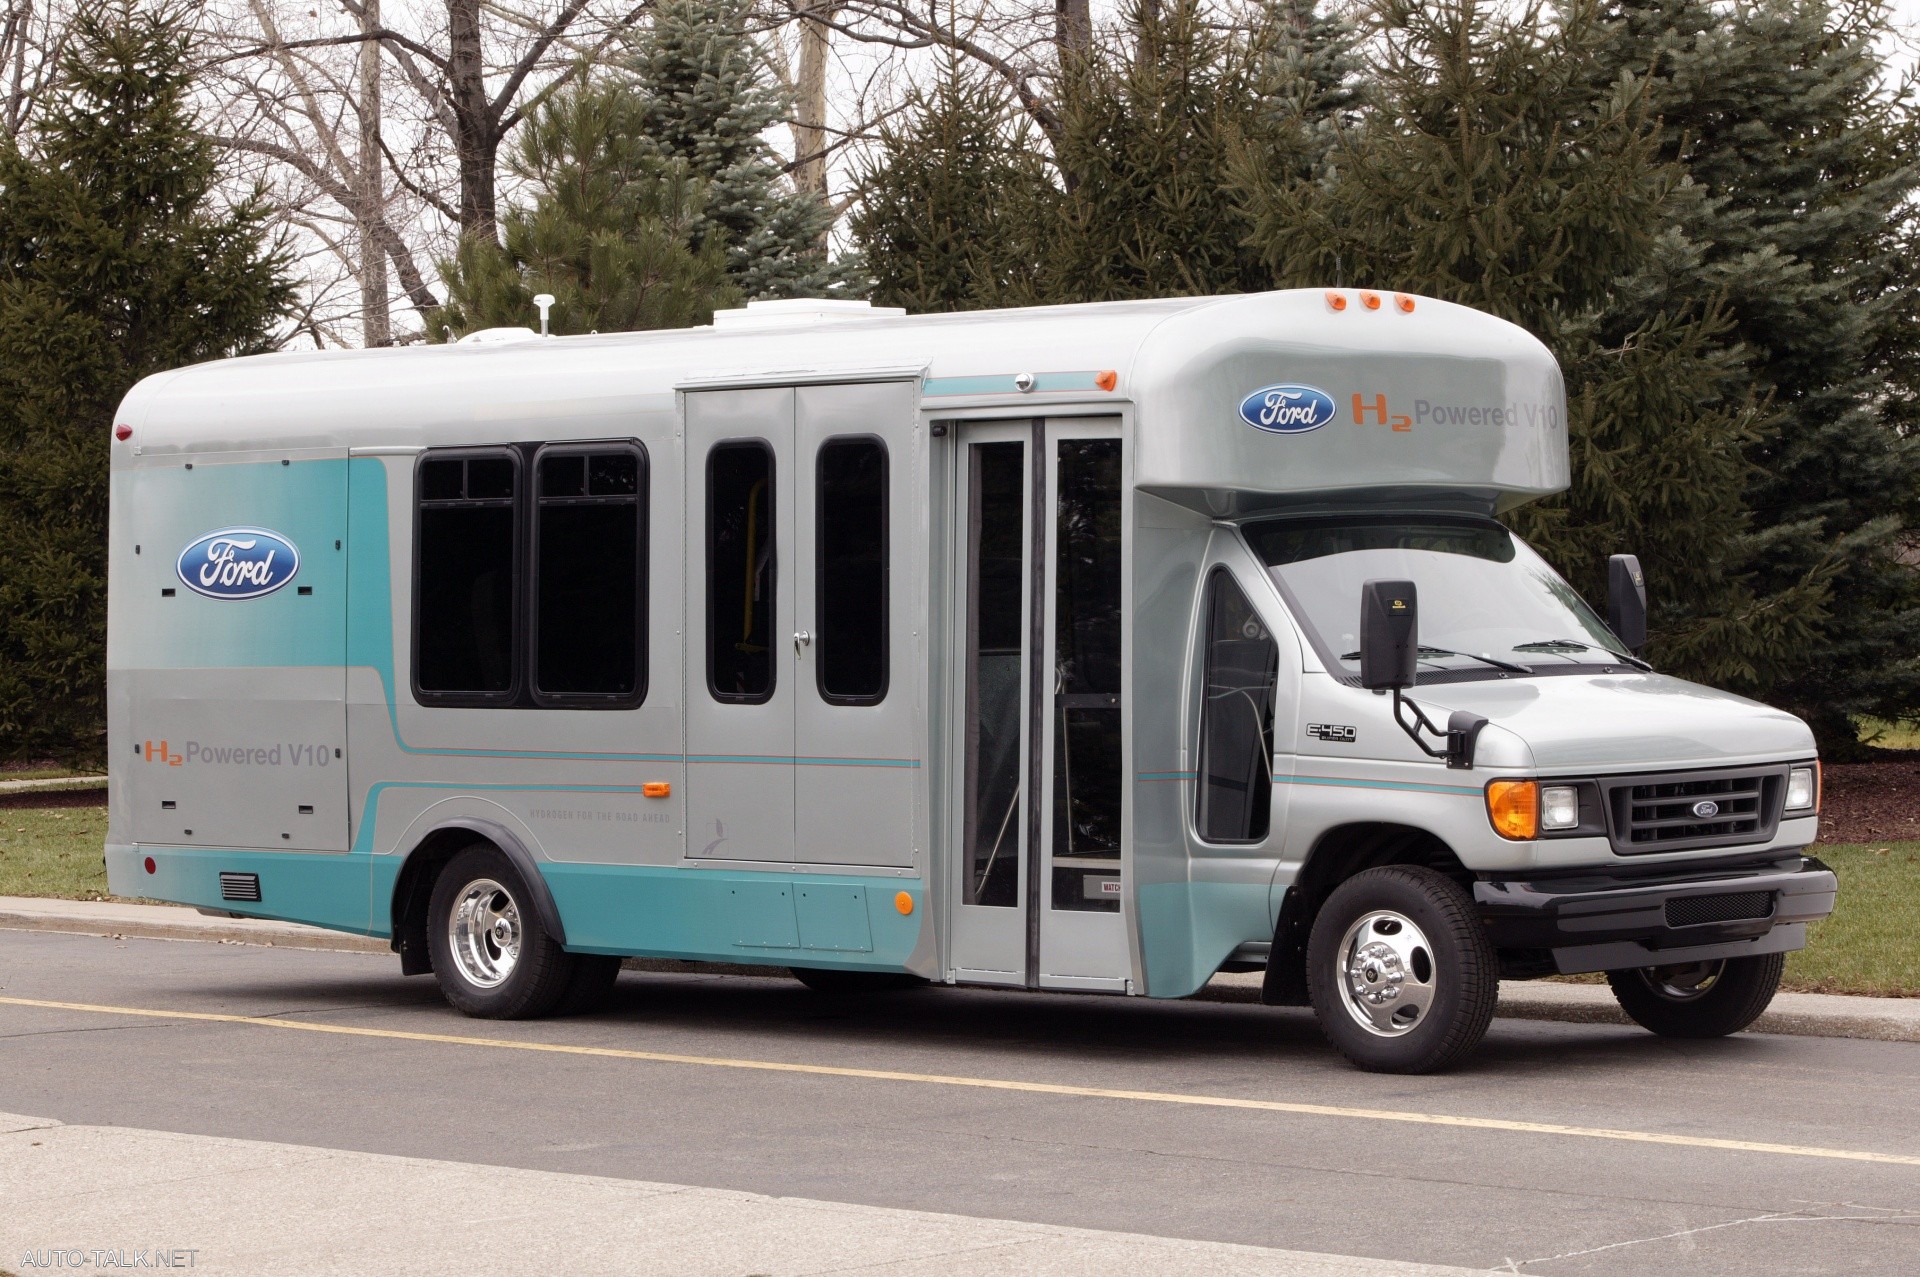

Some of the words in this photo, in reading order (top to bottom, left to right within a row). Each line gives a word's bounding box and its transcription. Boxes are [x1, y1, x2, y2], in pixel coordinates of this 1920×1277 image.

[1260, 391, 1317, 425] Ford
[1415, 400, 1518, 427] Powered
[1524, 402, 1558, 430] V10
[200, 538, 275, 587] Ford
[186, 741, 282, 766] Powered
[288, 743, 330, 767] V10
[530, 809, 573, 820] HYDROGEN
[577, 811, 592, 820] FOR
[597, 811, 612, 821] THE
[616, 812, 637, 822] ROAD
[642, 813, 670, 823] AHEAD
